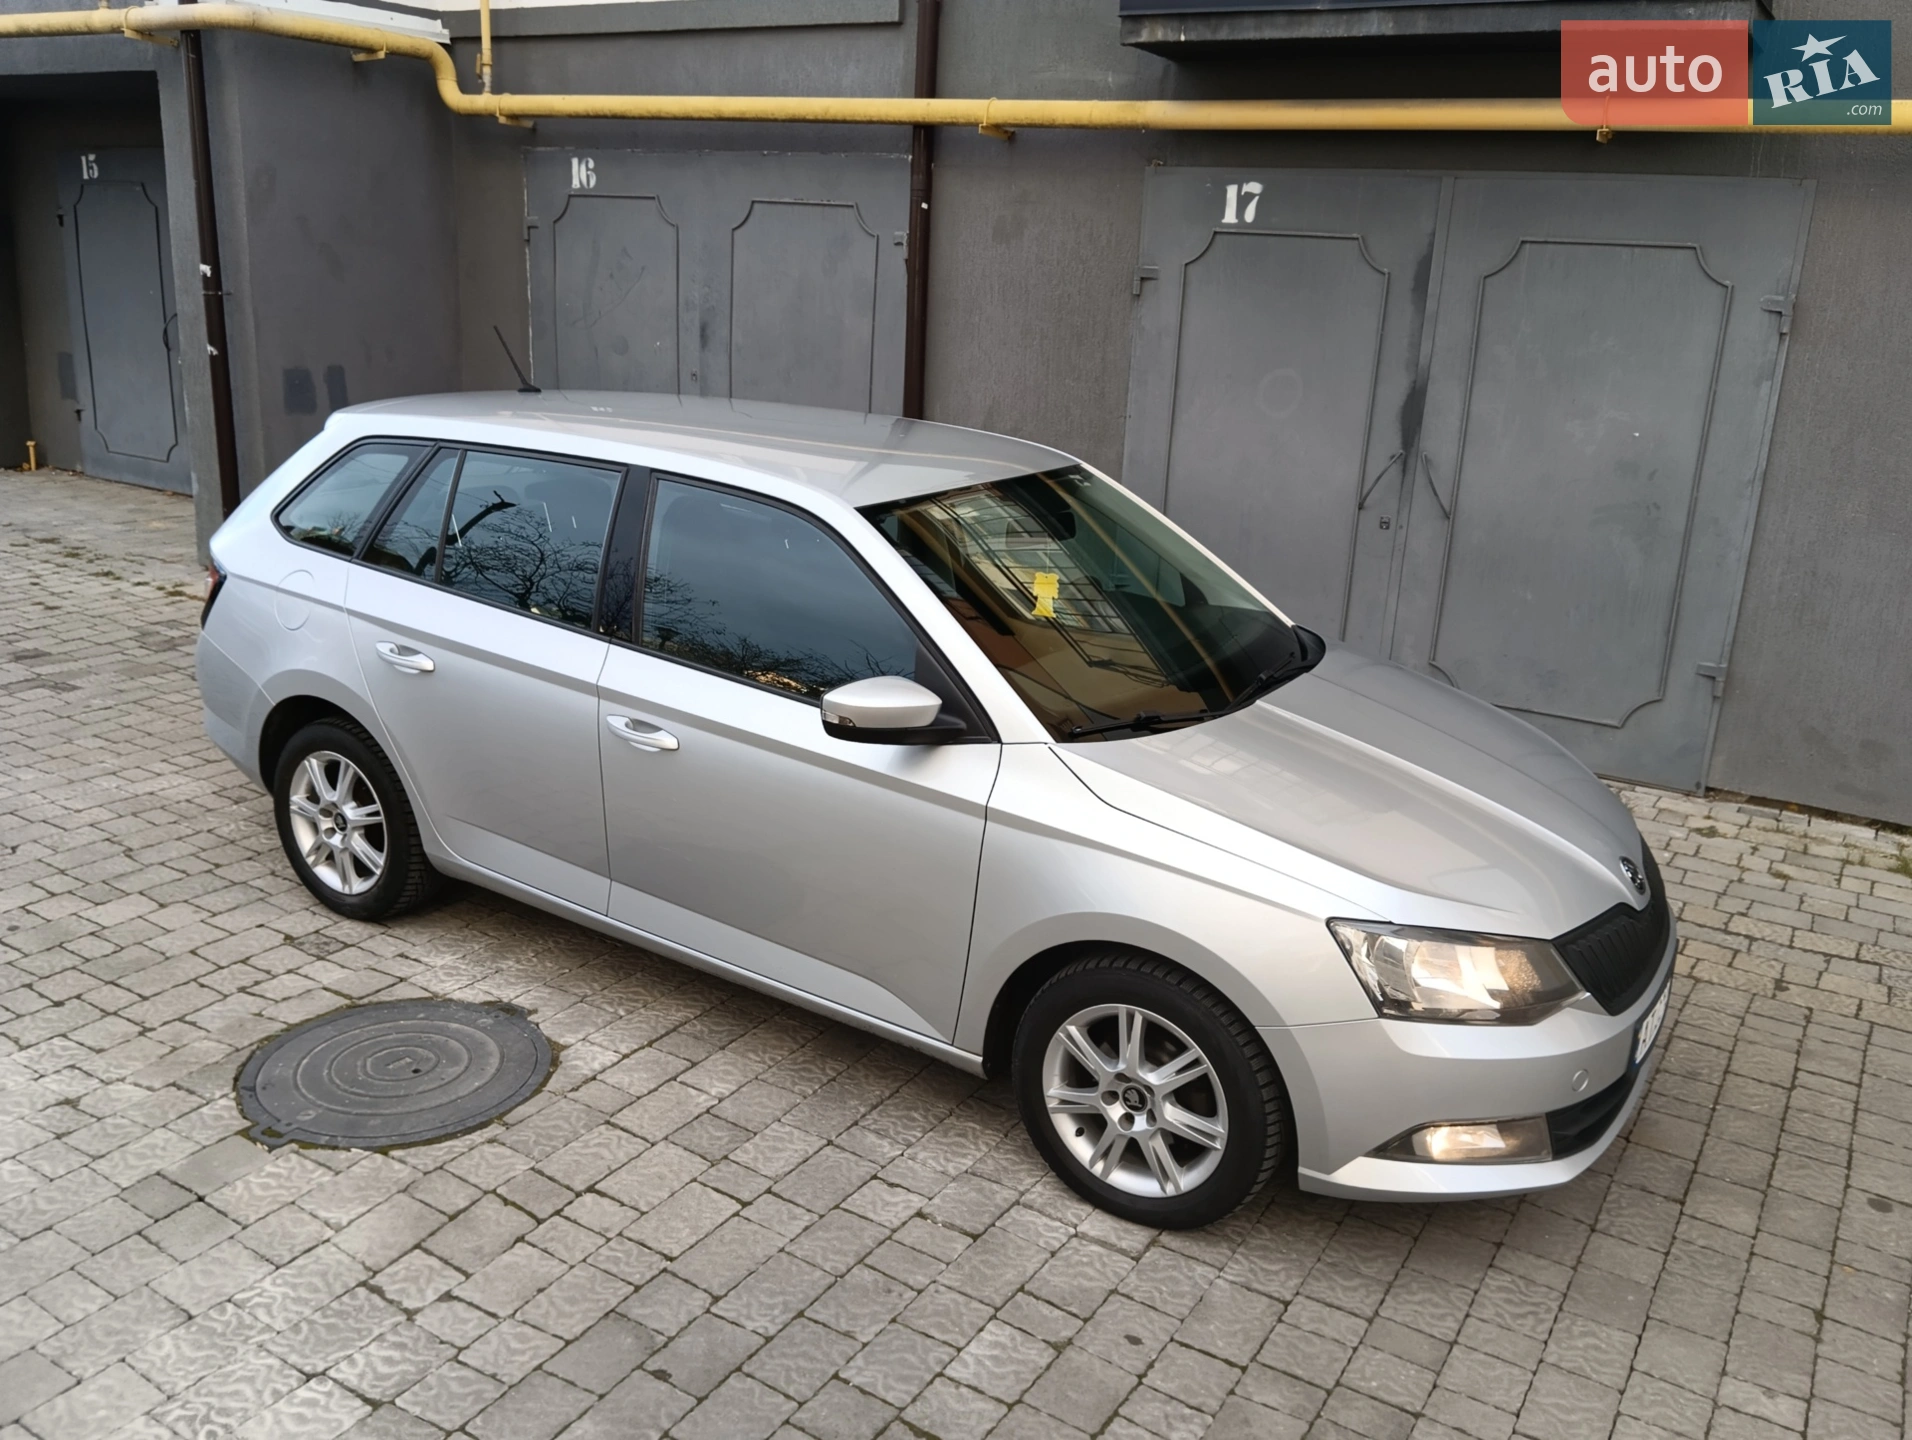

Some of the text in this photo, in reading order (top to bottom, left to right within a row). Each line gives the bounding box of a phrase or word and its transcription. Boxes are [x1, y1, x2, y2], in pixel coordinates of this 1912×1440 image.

[80, 153, 99, 180] 15
[571, 156, 597, 189] 16
[1221, 181, 1264, 224] 17
